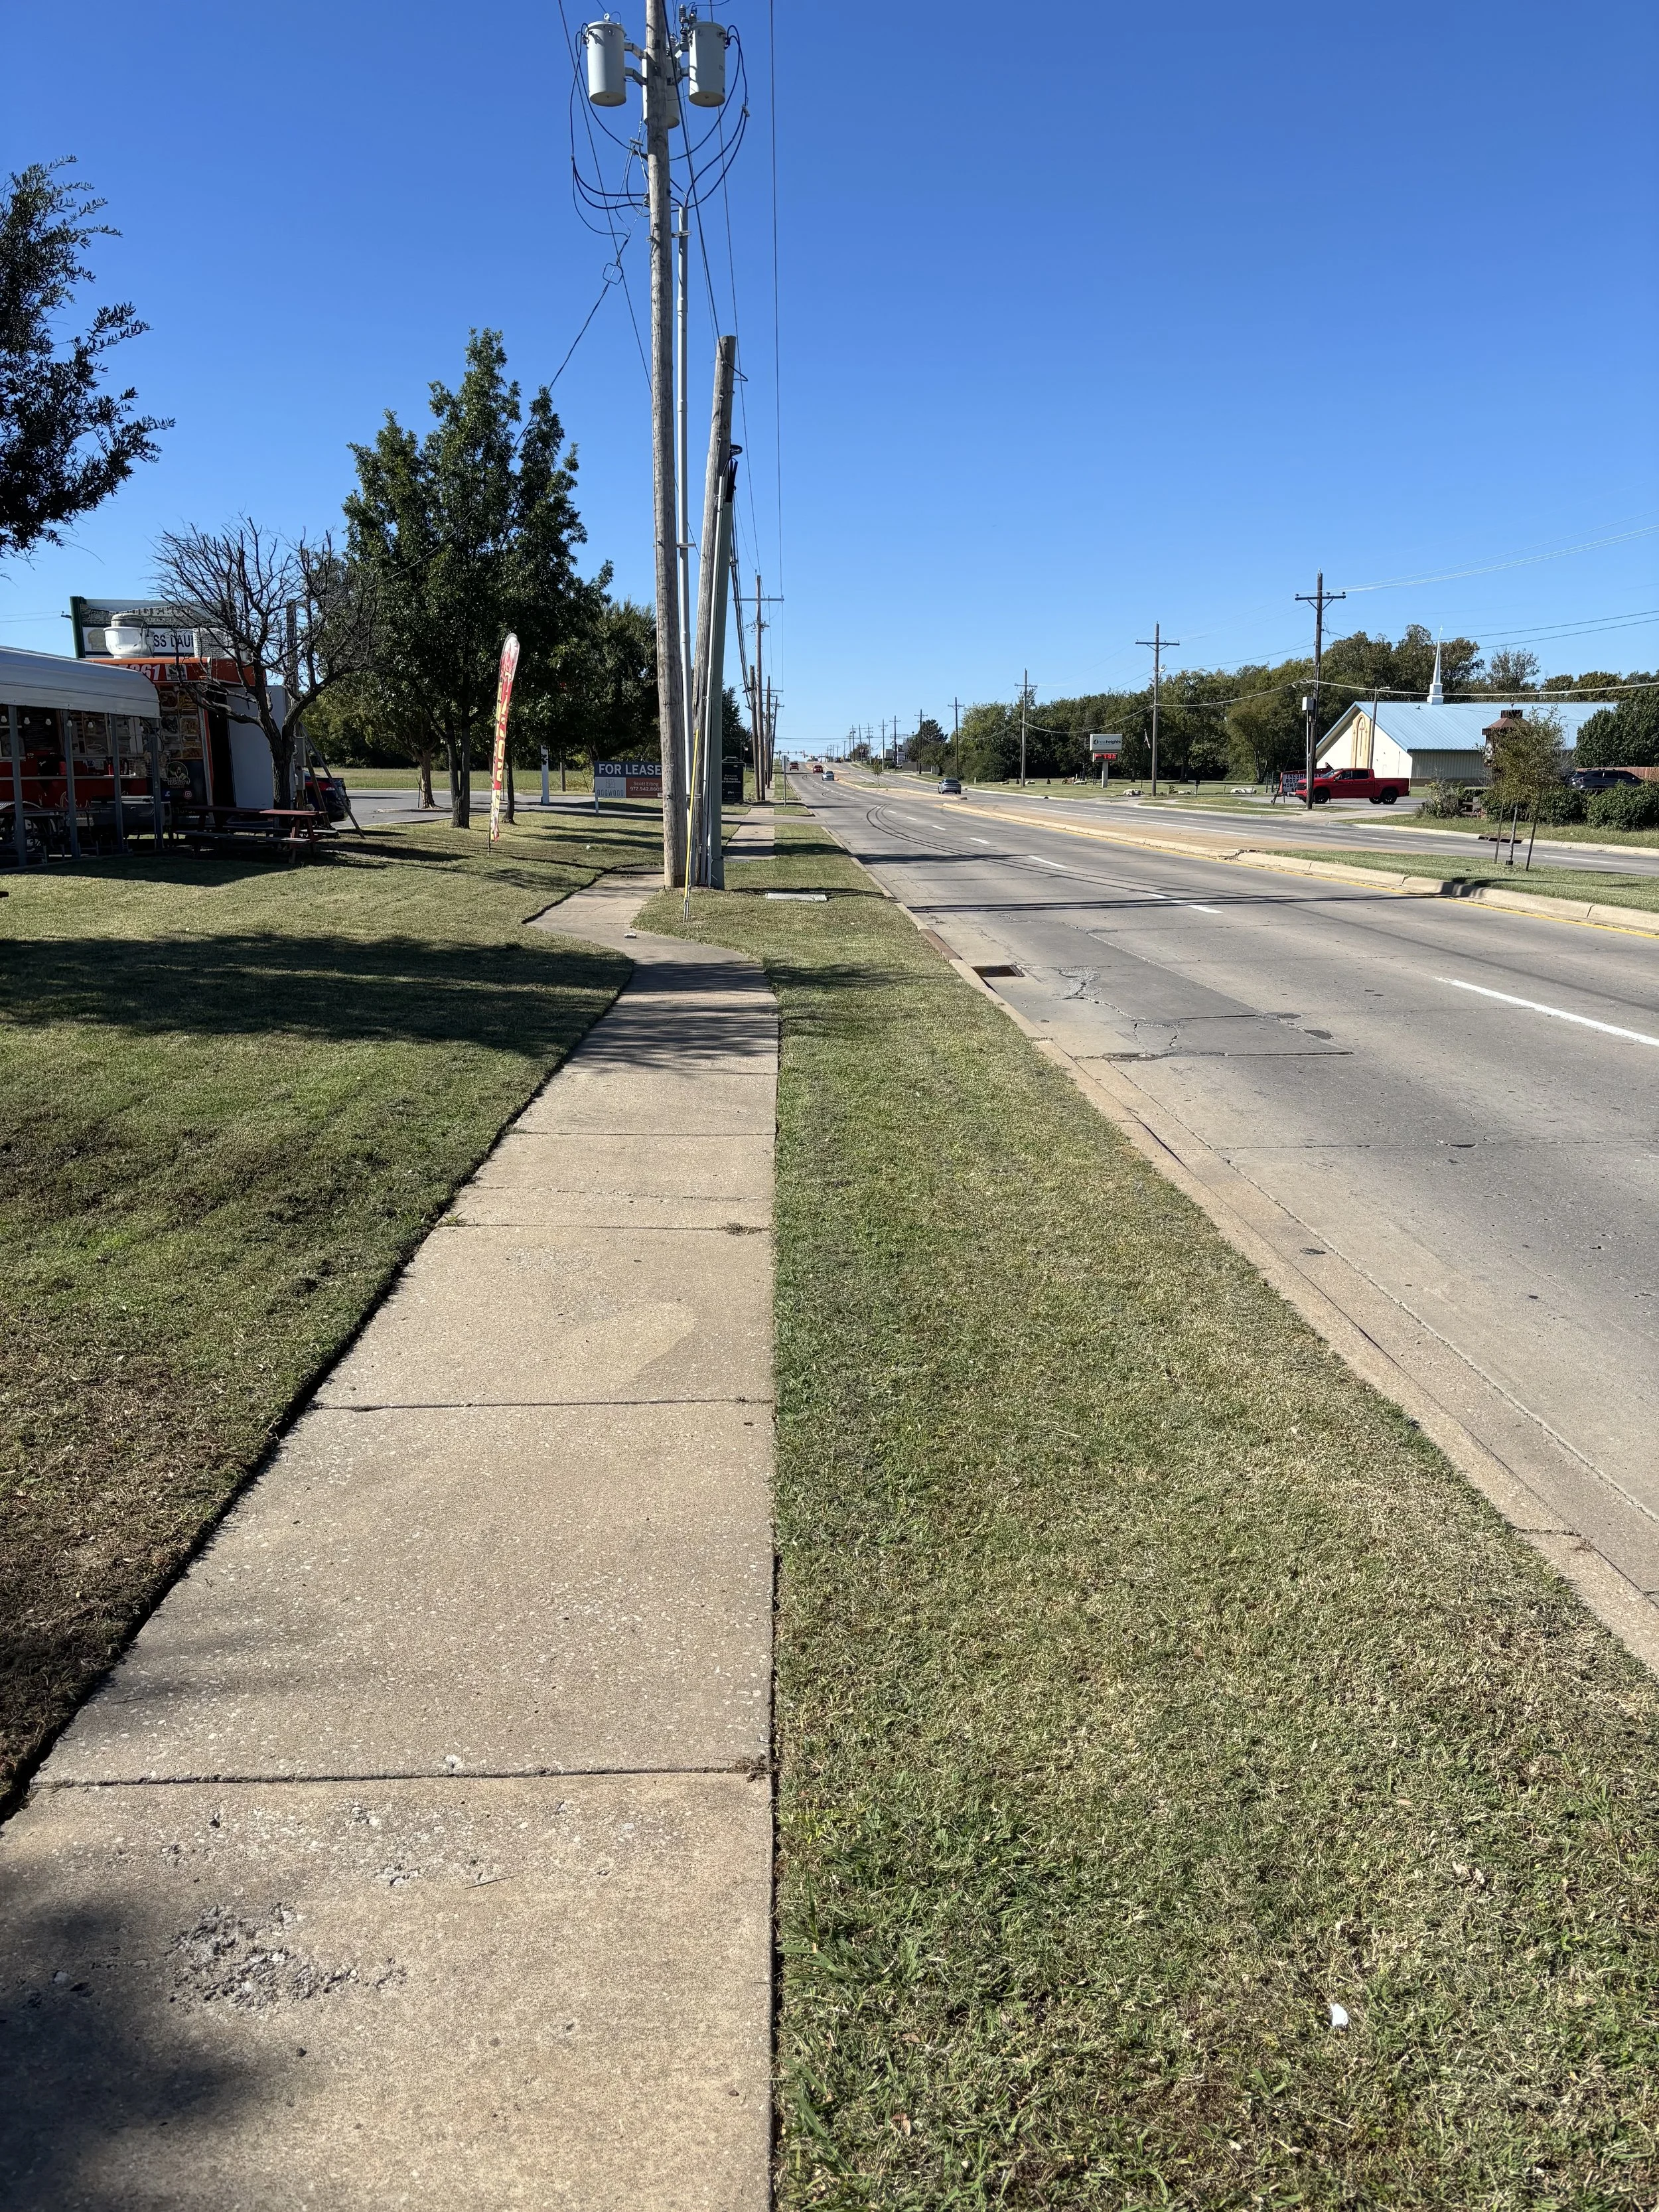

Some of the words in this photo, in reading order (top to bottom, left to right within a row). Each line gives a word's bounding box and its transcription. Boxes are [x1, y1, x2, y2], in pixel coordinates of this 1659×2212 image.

[153, 634, 167, 648] SS
[599, 763, 622, 774] FOR
[625, 764, 662, 776] LEASE
